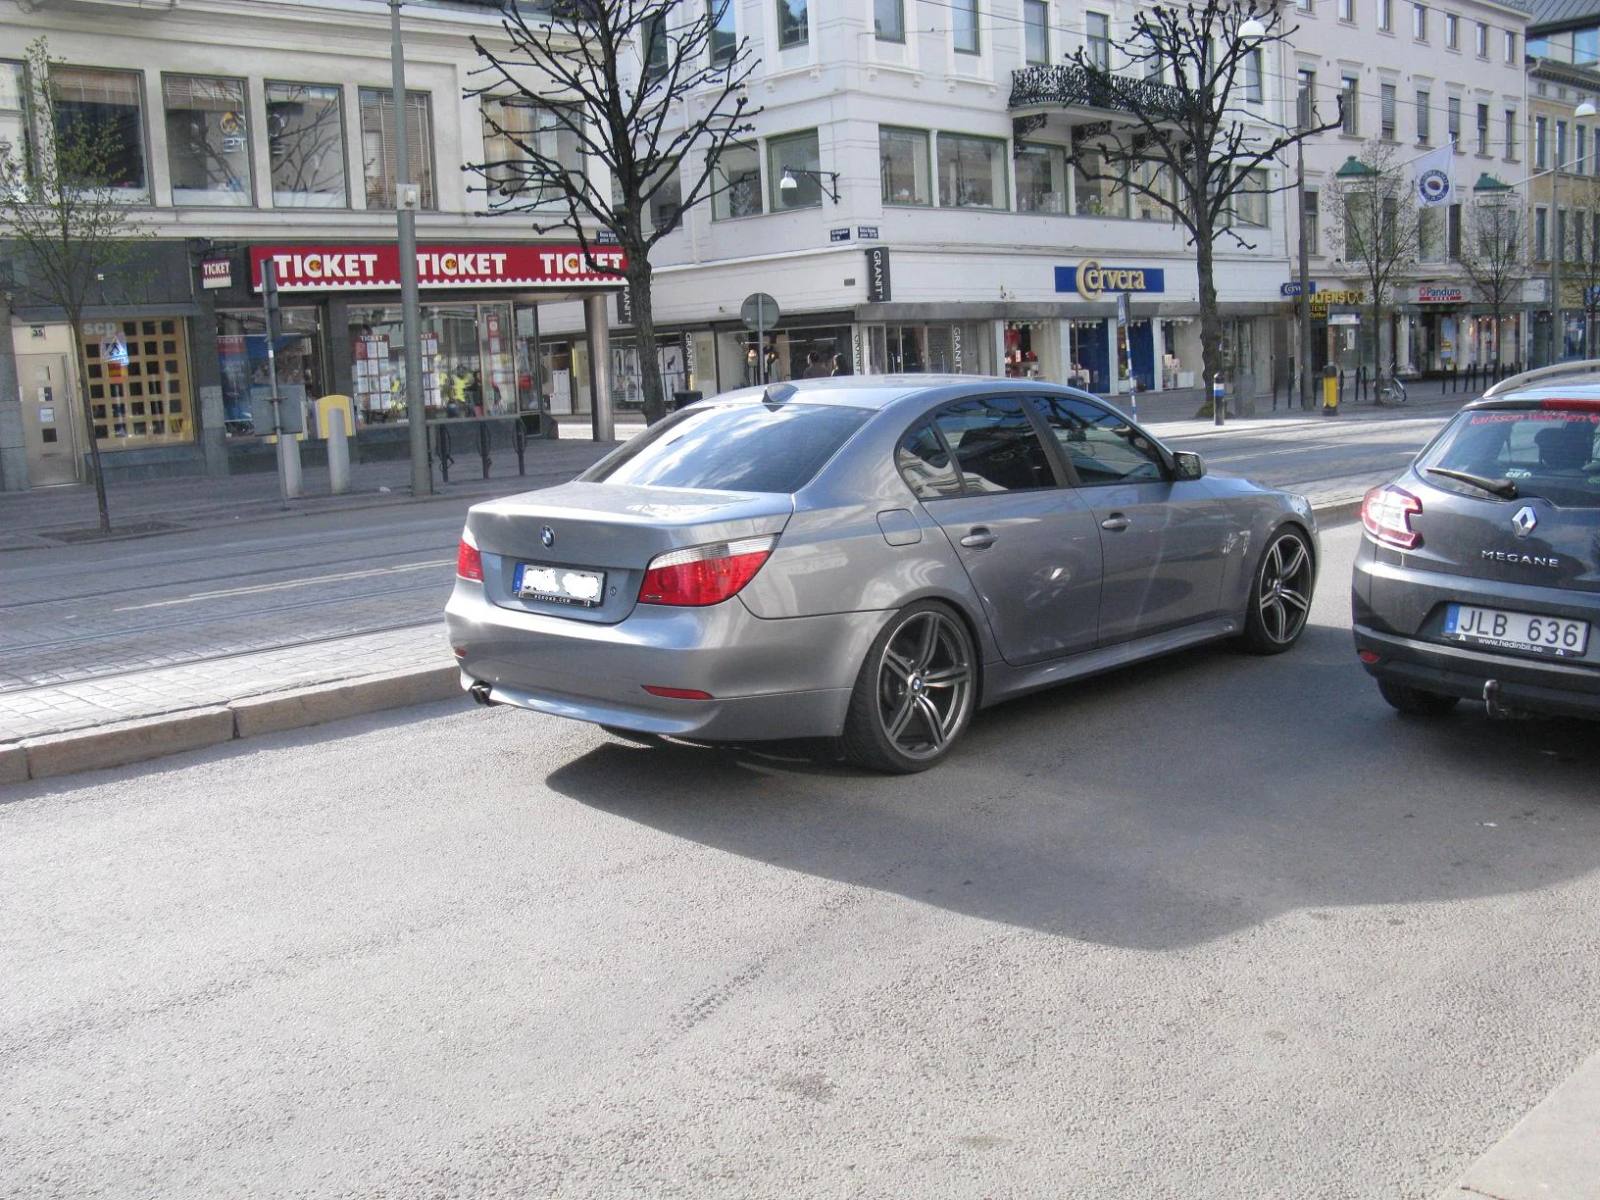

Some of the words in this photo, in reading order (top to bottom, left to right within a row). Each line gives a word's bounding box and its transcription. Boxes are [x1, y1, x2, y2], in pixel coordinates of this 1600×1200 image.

[203, 262, 231, 276] TICKET
[273, 253, 378, 278] TICKET
[416, 253, 507, 276] TICKET
[873, 250, 883, 294] GRANIT
[1076, 258, 1146, 301] Cervera
[1426, 286, 1461, 297] Panduro
[623, 286, 632, 317] RANIT
[953, 327, 962, 368] GRANIT
[1481, 550, 1560, 568] MEGANE
[1460, 610, 1508, 637] JLB
[1527, 618, 1579, 647] 636
[1478, 637, 1544, 653] www.hedinbil.se
